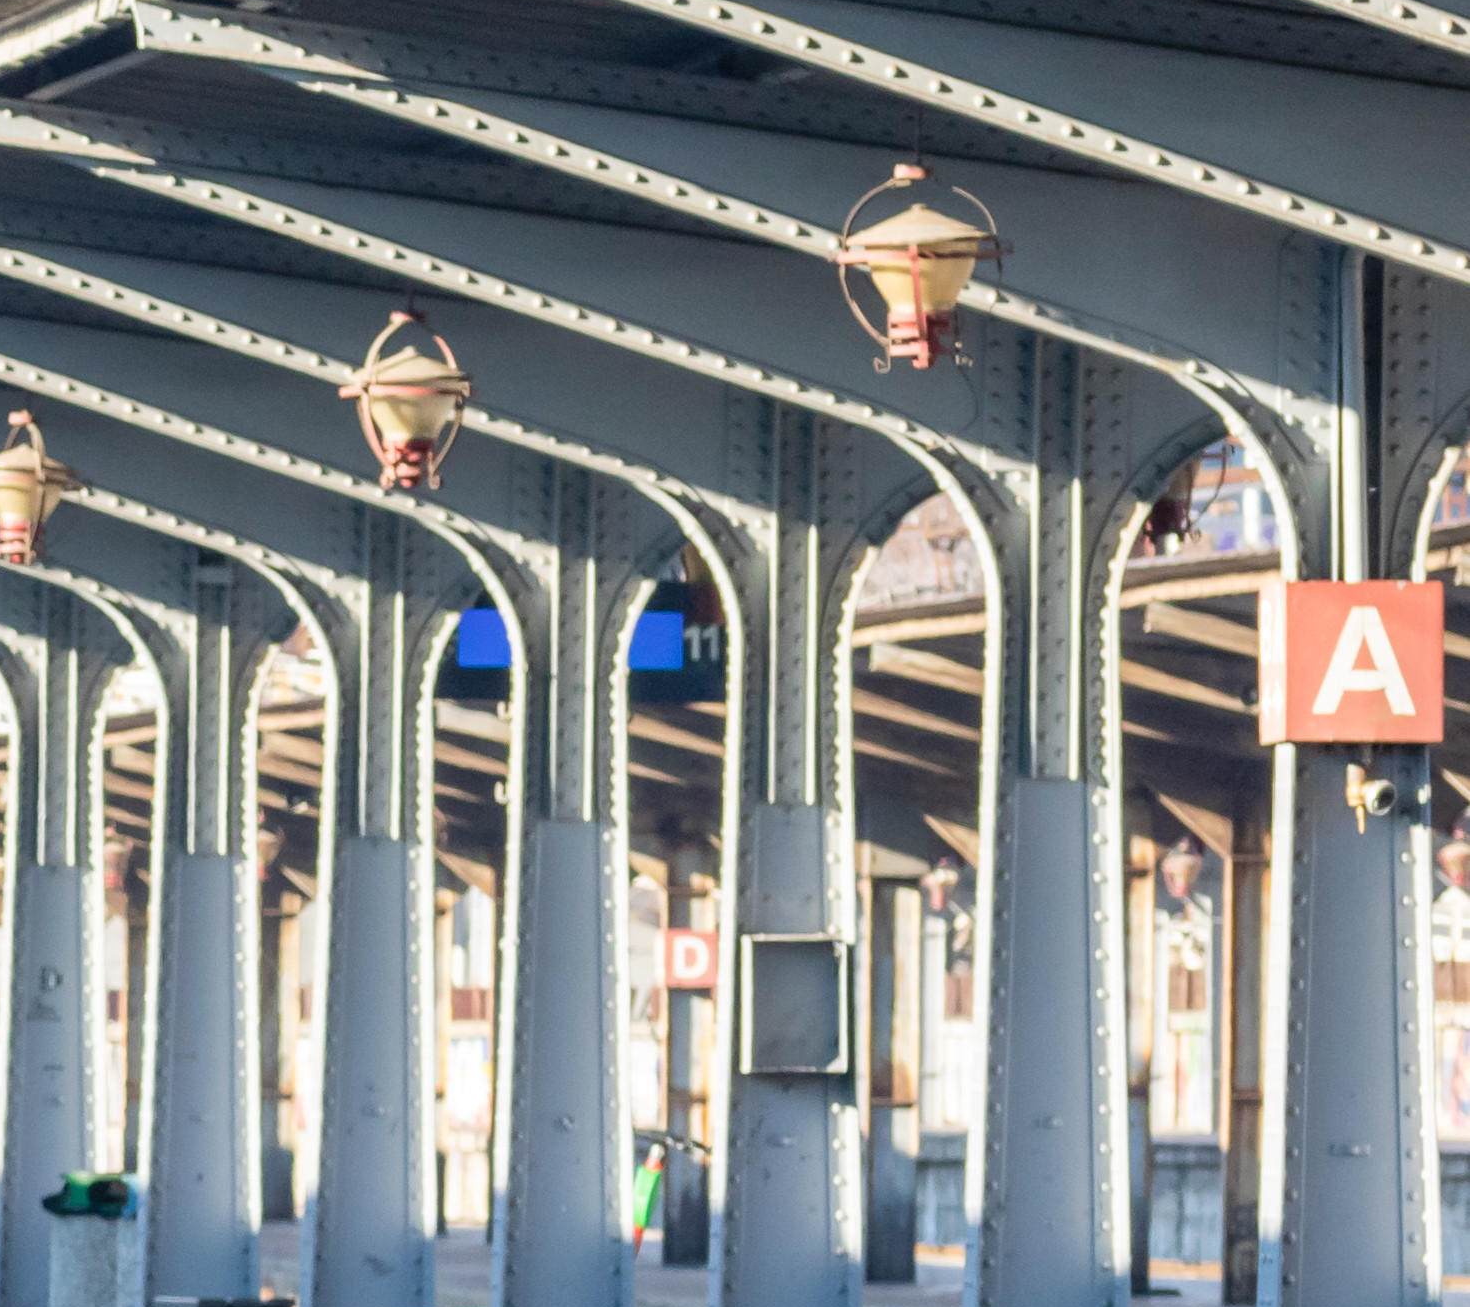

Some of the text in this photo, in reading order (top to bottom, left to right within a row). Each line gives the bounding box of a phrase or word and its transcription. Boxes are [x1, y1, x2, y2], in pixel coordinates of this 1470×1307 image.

[684, 624, 719, 662] 11
[1312, 606, 1416, 715] A
[673, 935, 710, 980] D
